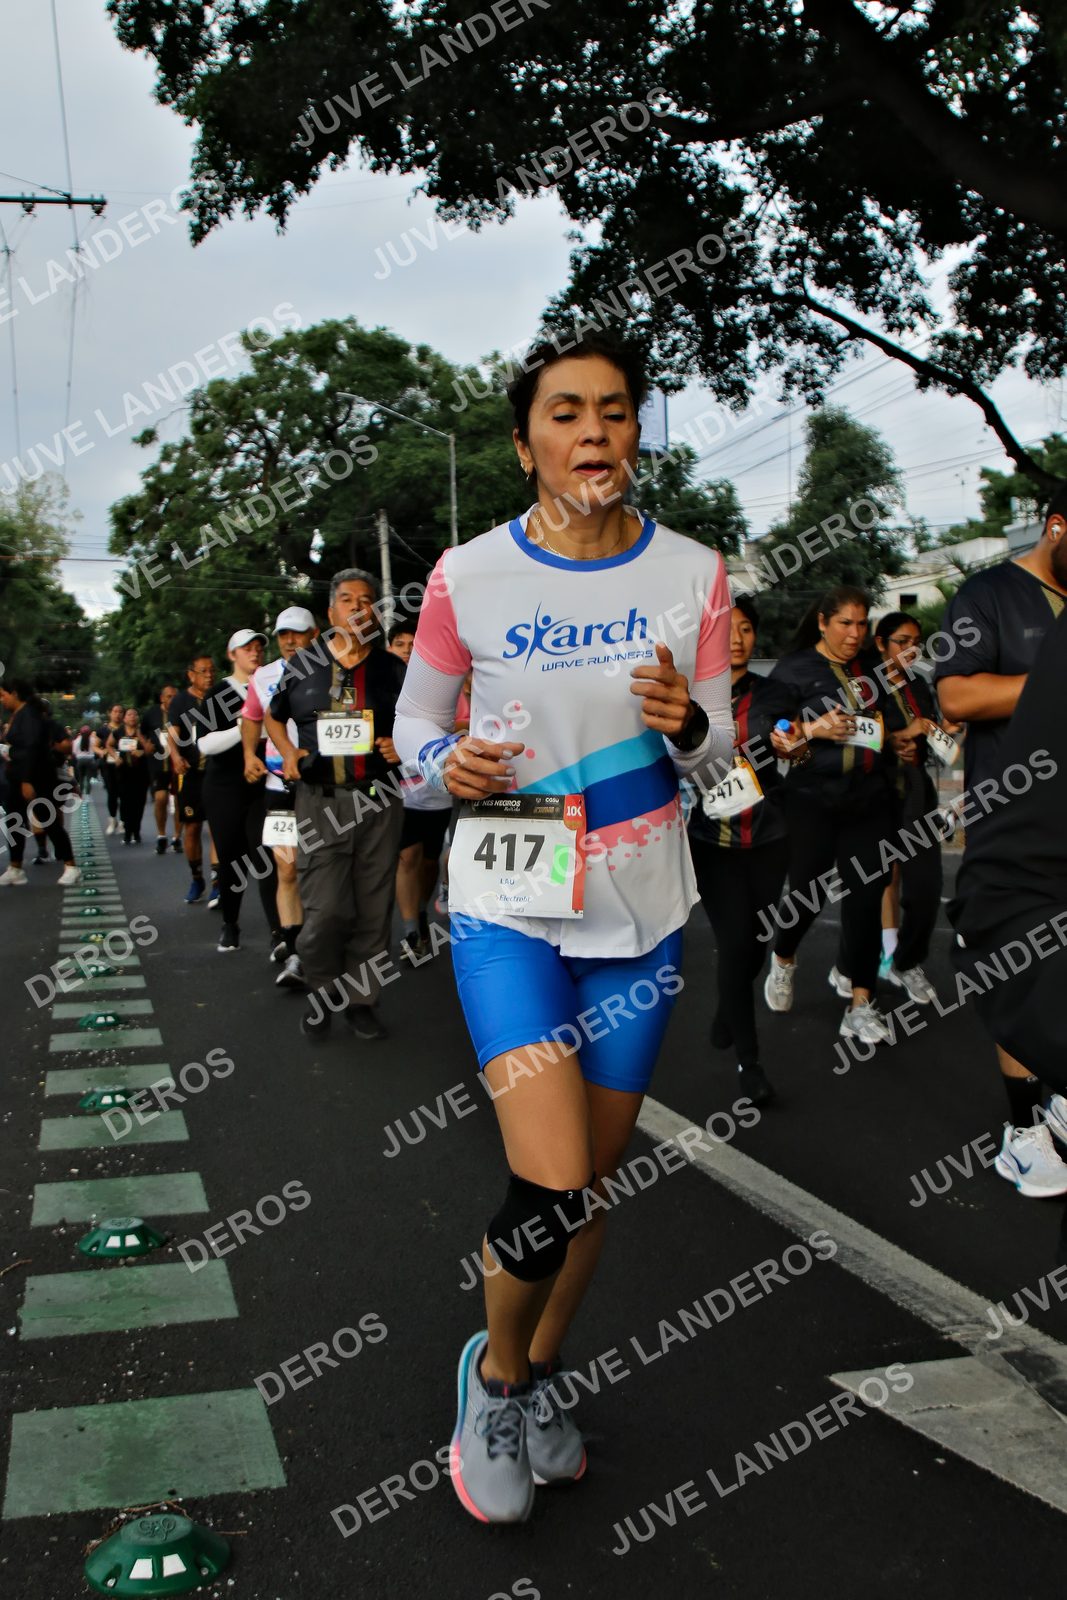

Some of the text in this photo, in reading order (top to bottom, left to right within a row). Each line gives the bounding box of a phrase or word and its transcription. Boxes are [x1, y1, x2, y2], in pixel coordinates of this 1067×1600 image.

[542, 649, 654, 672] WAVE RUNNERS
[325, 724, 361, 740] 4975
[566, 805, 582, 817] 10K
[473, 832, 546, 872] 417
